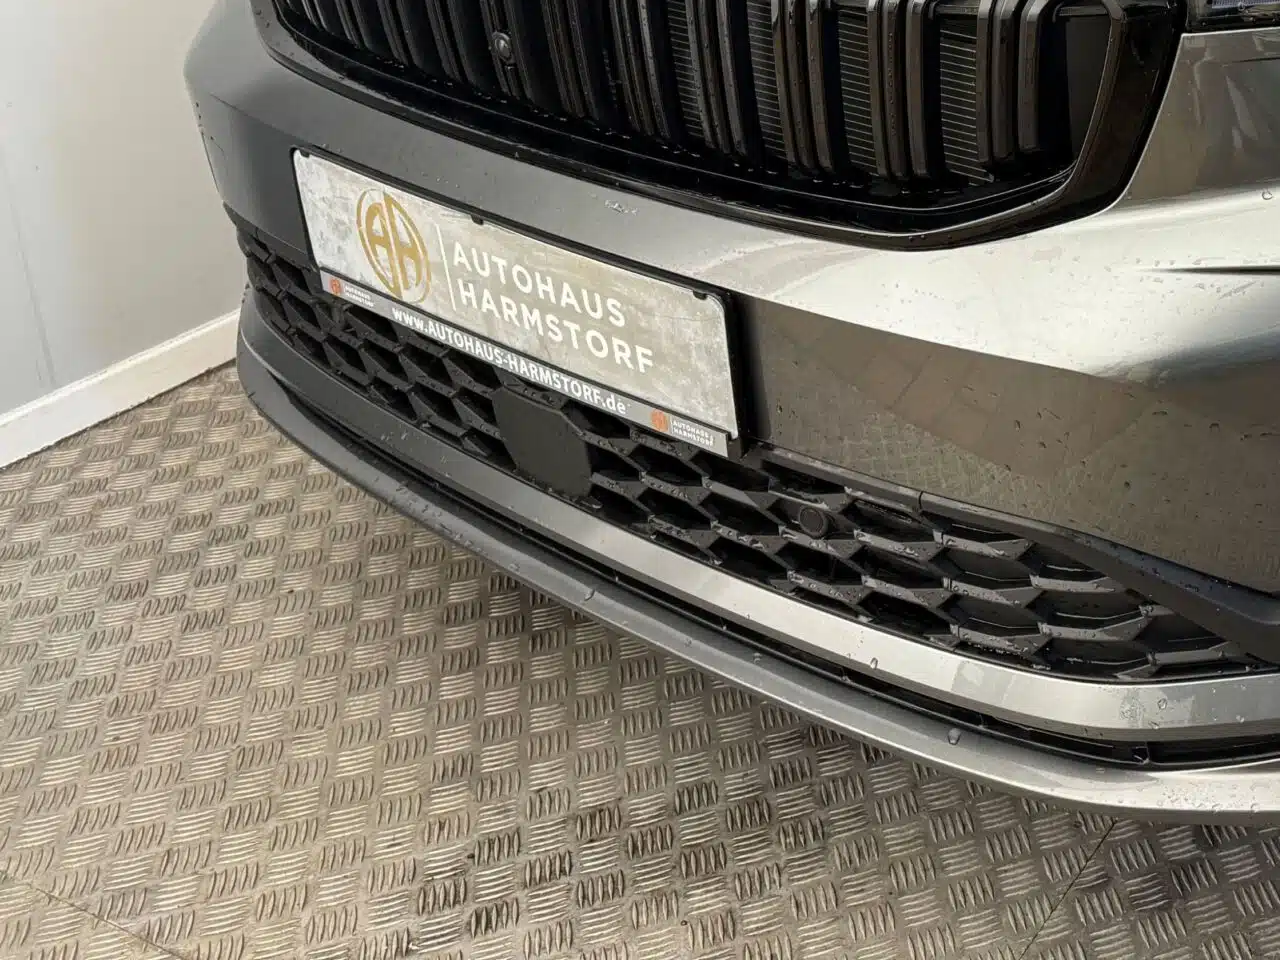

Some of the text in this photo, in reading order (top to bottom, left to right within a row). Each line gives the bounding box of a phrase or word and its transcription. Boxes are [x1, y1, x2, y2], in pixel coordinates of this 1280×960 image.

[453, 240, 626, 328] AUTOHAUS
[457, 278, 655, 373] HARMSTORF
[391, 306, 627, 415] www.AUTOHAUS-HARMSTORF.de
